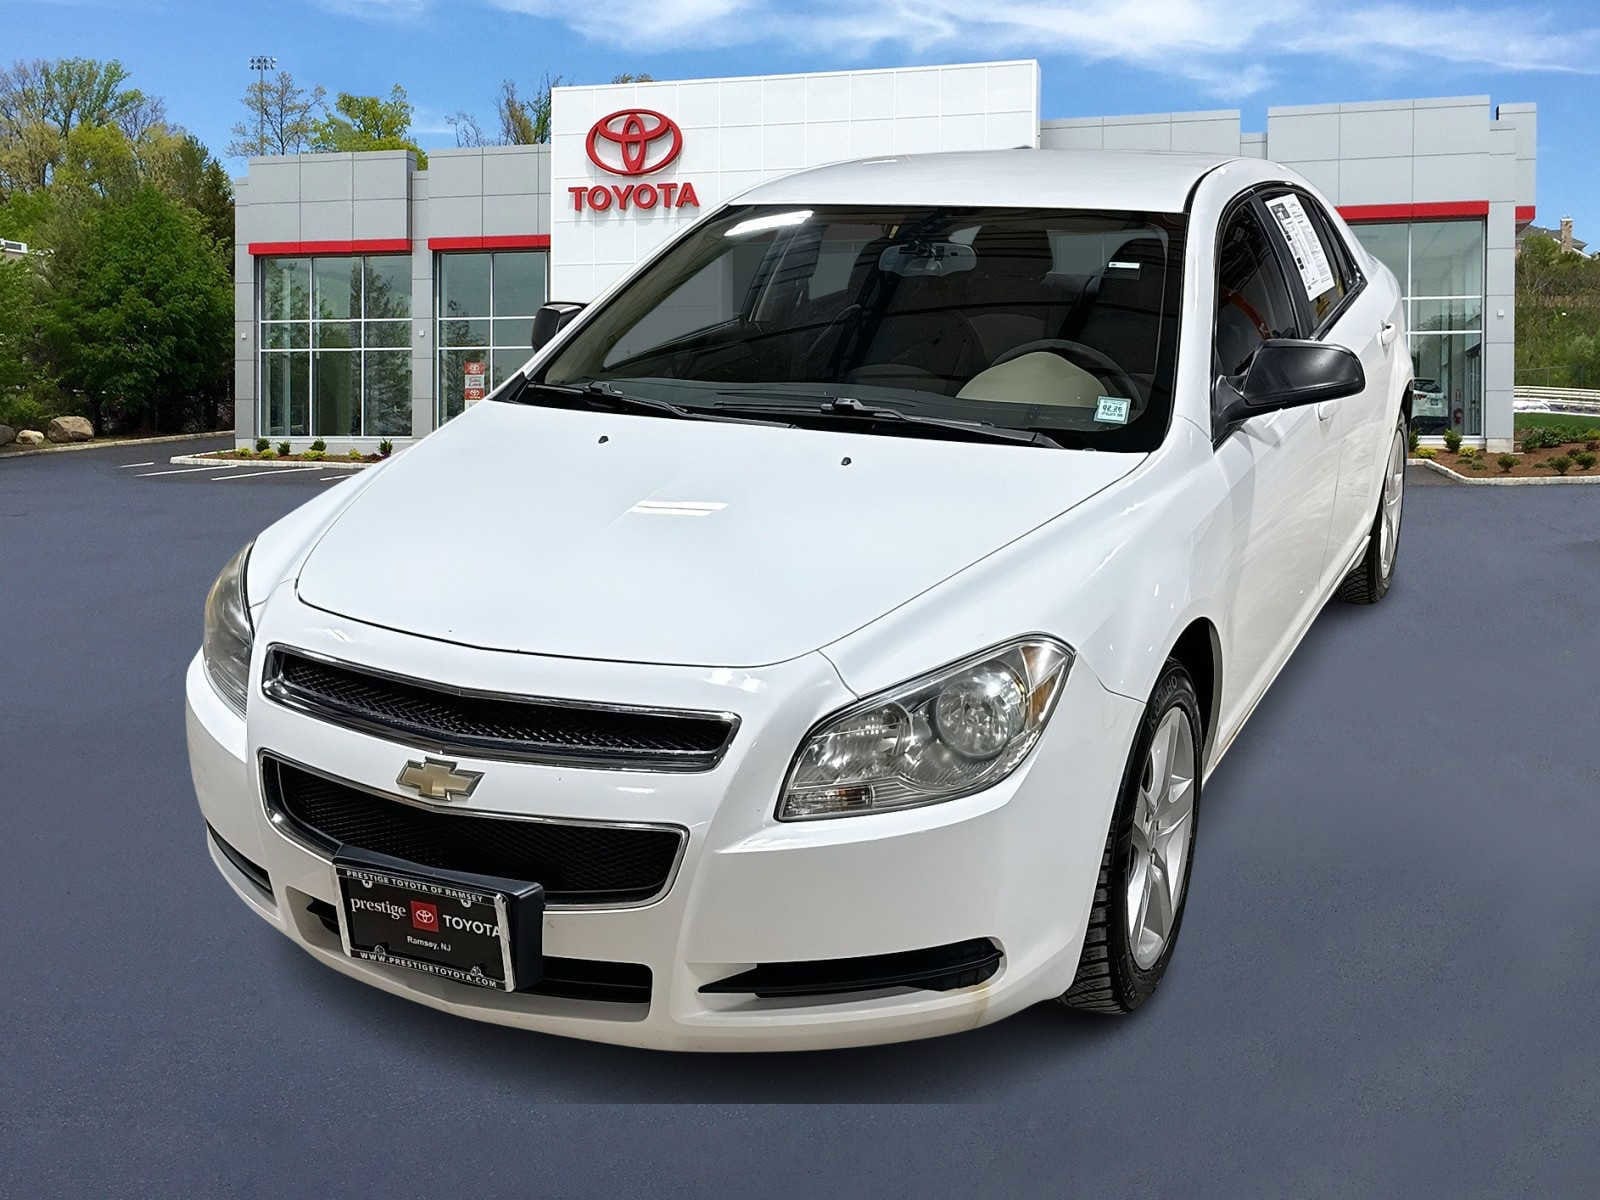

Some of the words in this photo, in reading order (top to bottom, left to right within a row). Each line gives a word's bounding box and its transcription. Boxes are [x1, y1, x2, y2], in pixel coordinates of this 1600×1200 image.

[568, 182, 700, 212] TOYOTA
[346, 870, 389, 885] PRESTIGE
[391, 878, 428, 893] TOYOTA
[430, 886, 444, 896] OF
[444, 889, 483, 903] RAMSEY
[350, 897, 407, 920] prestige
[442, 914, 501, 938] TOYOTA
[406, 935, 440, 951] Ramsey,
[440, 941, 452, 952] NJ
[360, 951, 497, 989] WWW.PRESTIGETOYOTA.COM
